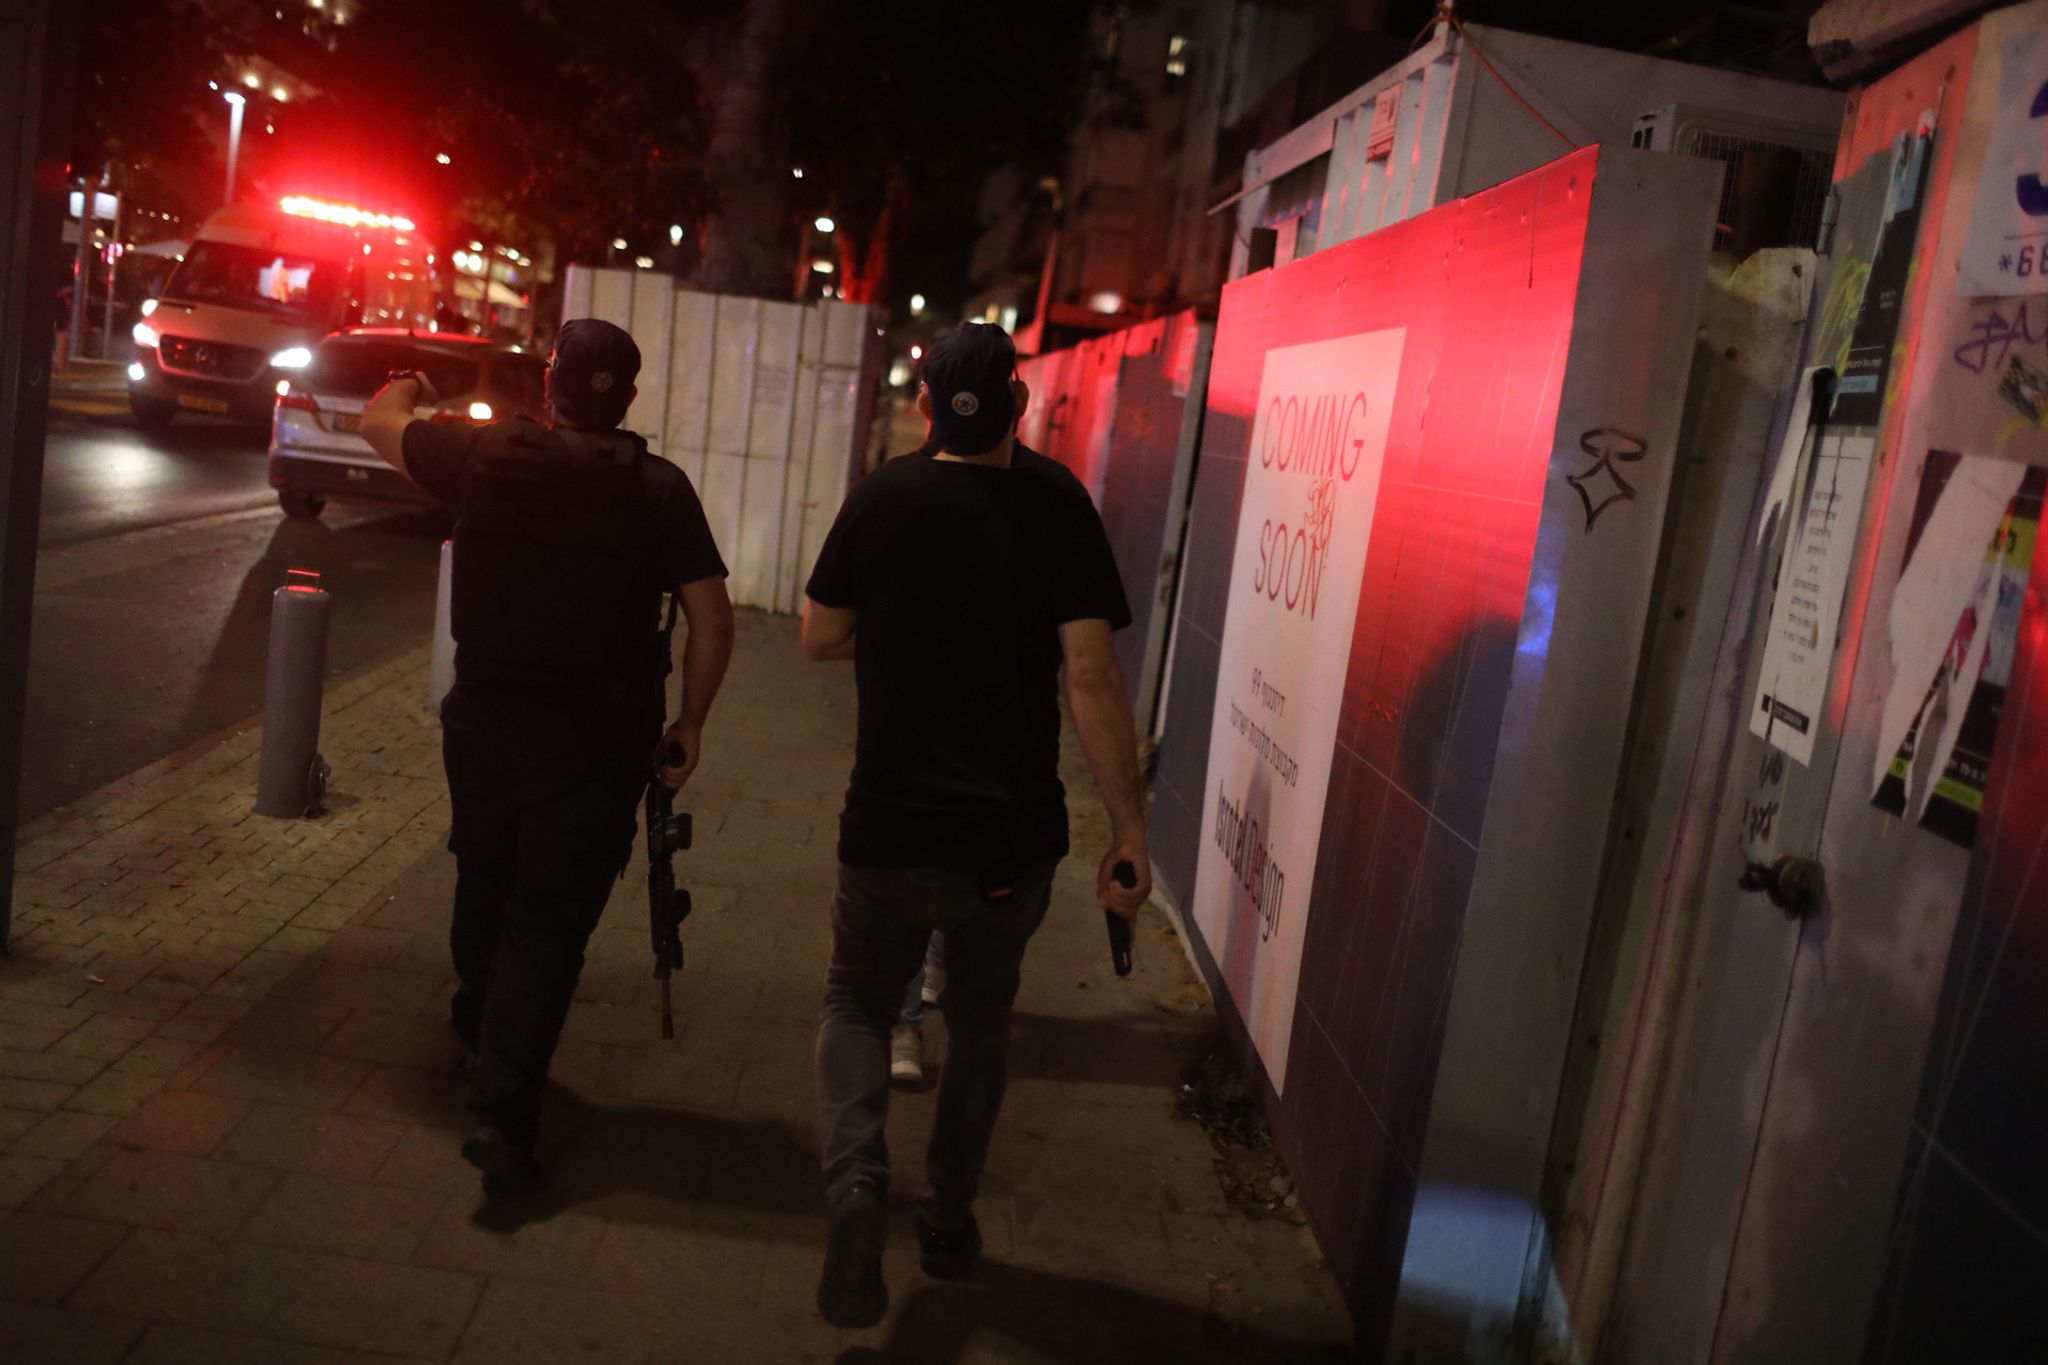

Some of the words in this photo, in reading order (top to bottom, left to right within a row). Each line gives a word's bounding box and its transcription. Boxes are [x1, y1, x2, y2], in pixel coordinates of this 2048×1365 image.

[1262, 391, 1366, 482] COMING
[1255, 518, 1328, 621] SOON
[1252, 667, 1262, 697] 99
[1215, 778, 1249, 881] Isrotel
[1244, 818, 1284, 943] Design
